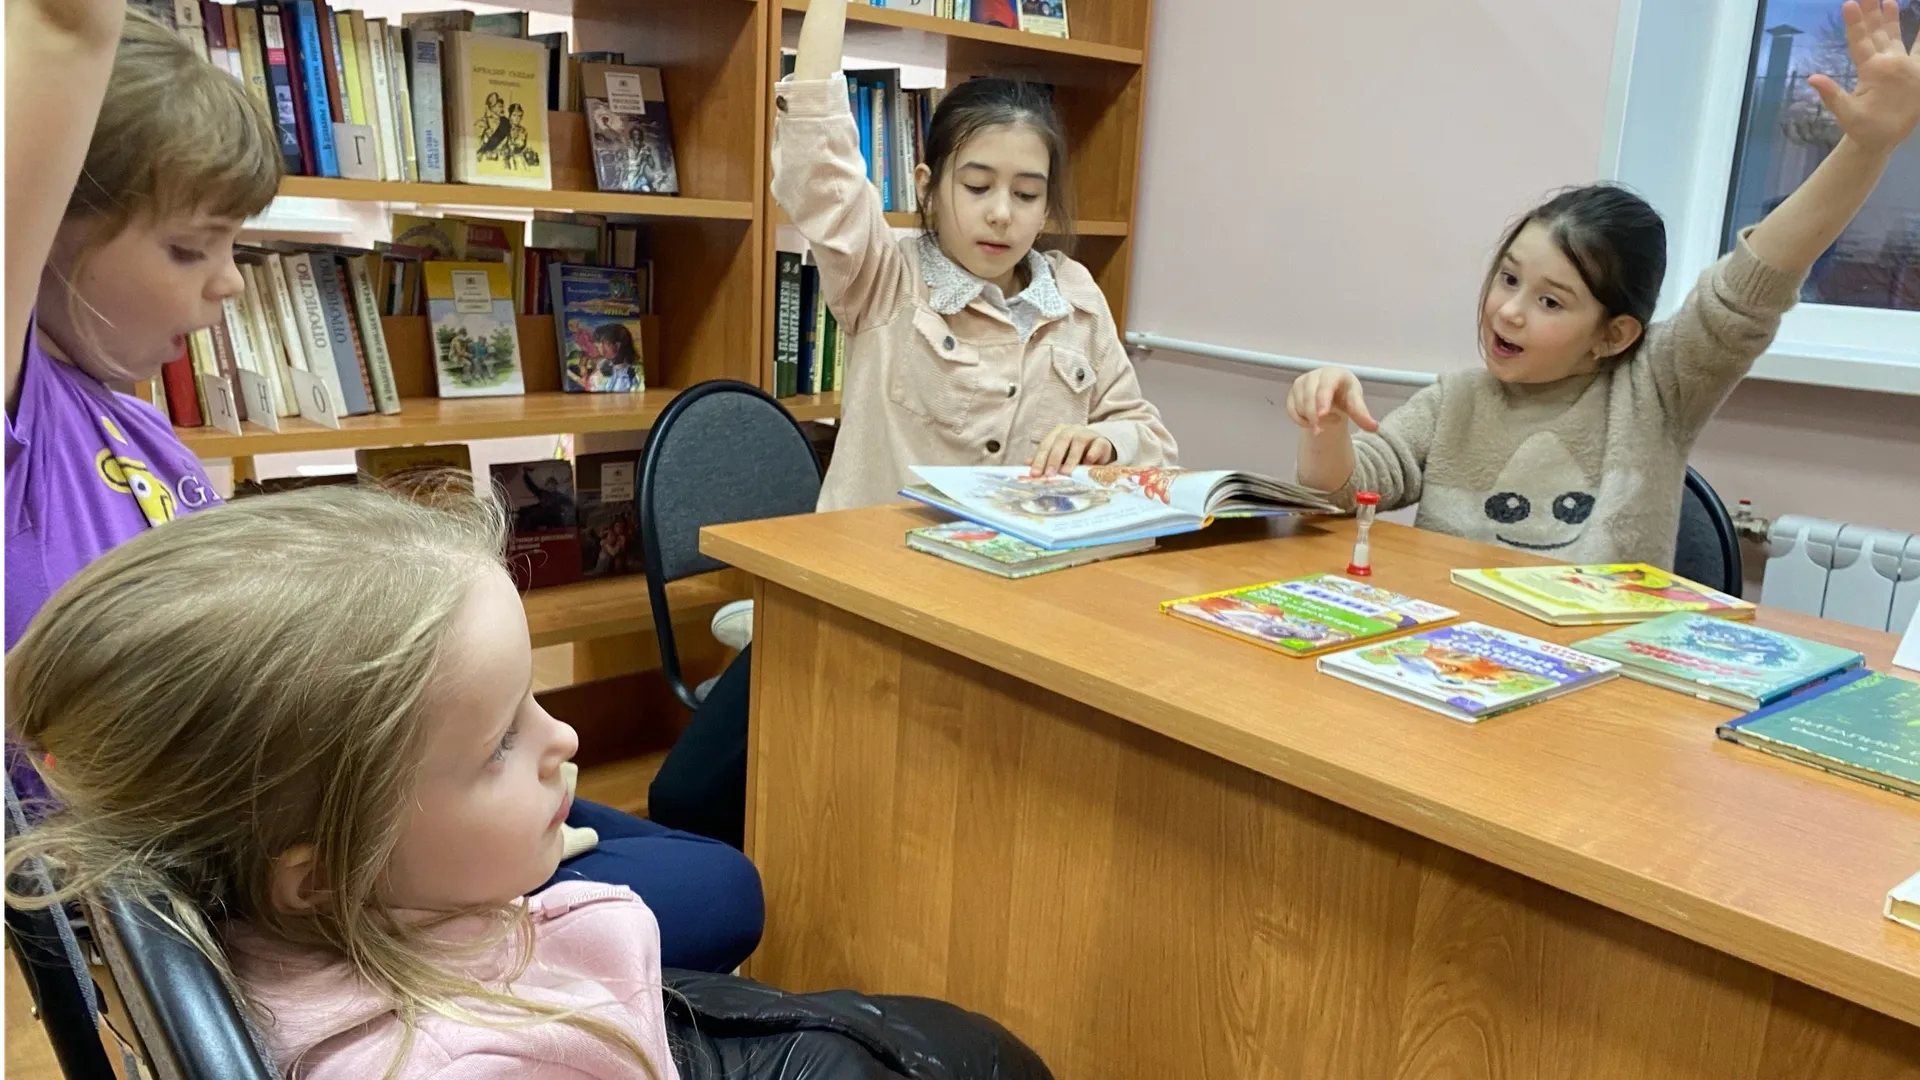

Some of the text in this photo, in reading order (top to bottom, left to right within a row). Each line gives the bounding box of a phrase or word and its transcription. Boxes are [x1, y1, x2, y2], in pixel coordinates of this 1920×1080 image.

[353, 136, 366, 165] Г
[295, 262, 328, 349] ОТРОЧЕСТВО
[319, 258, 348, 344] ОТРОЧЕСТВО
[778, 281, 790, 353] ПАНТЕЛЕЕВ
[789, 283, 801, 354] ПАНТЕЛЕЕВ
[257, 383, 271, 414] Н
[312, 385, 326, 414] О
